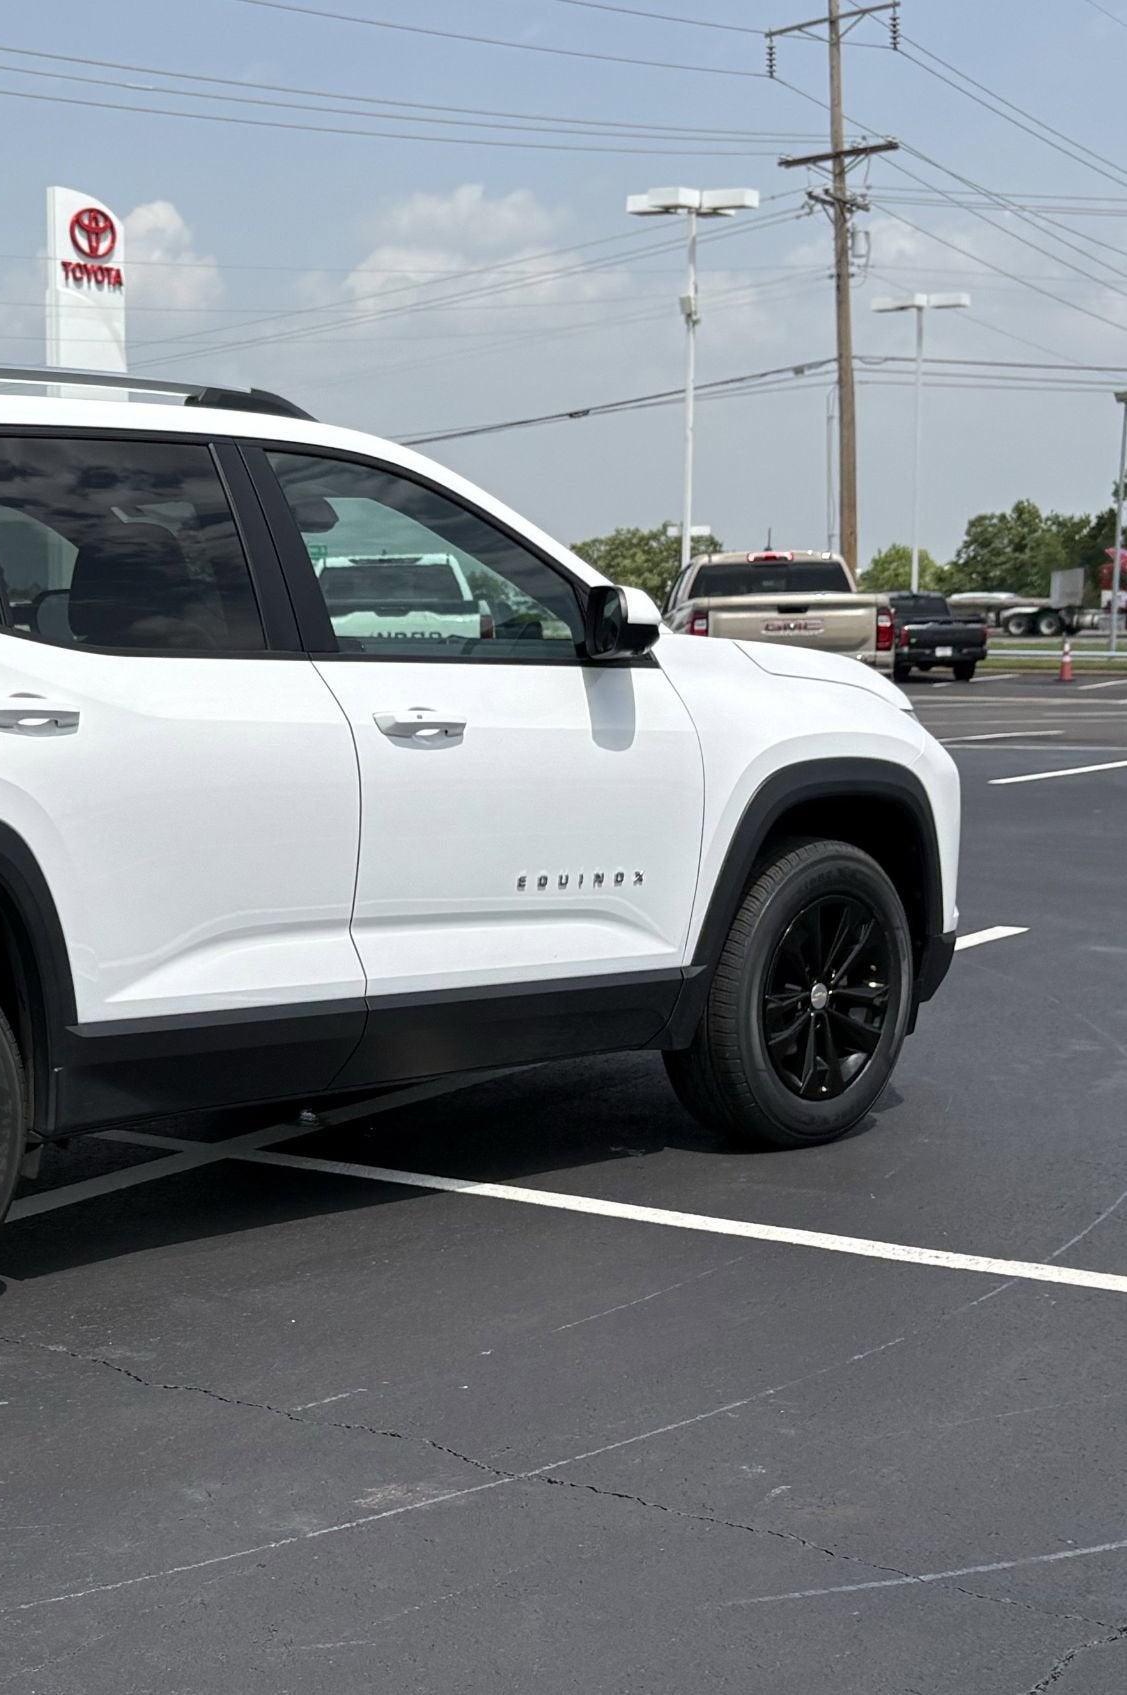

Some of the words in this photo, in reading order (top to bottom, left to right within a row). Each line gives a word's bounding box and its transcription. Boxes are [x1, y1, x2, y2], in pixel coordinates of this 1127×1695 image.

[61, 260, 123, 287] TOYOTA
[761, 618, 824, 633] GMC
[516, 871, 644, 889] EQUINOX
